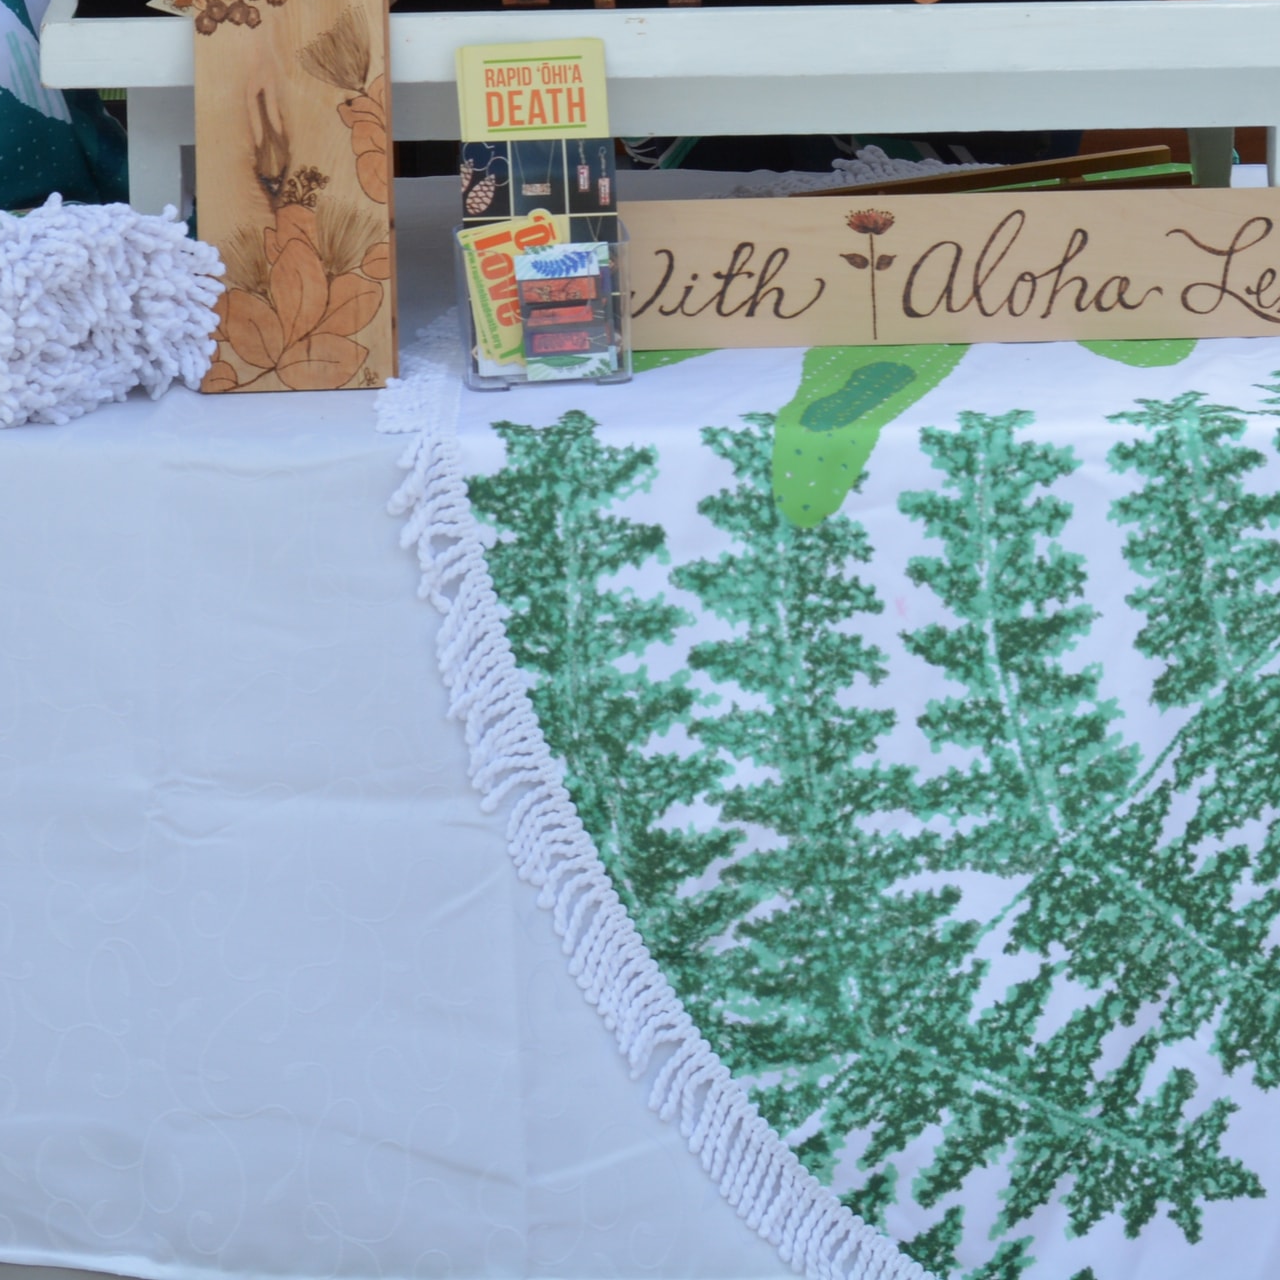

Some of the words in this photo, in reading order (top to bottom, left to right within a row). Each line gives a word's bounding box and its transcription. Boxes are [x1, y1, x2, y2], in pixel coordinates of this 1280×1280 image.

[484, 66, 533, 89] RAPID
[485, 86, 587, 128] DEATH
[902, 209, 1163, 320] Aloha
